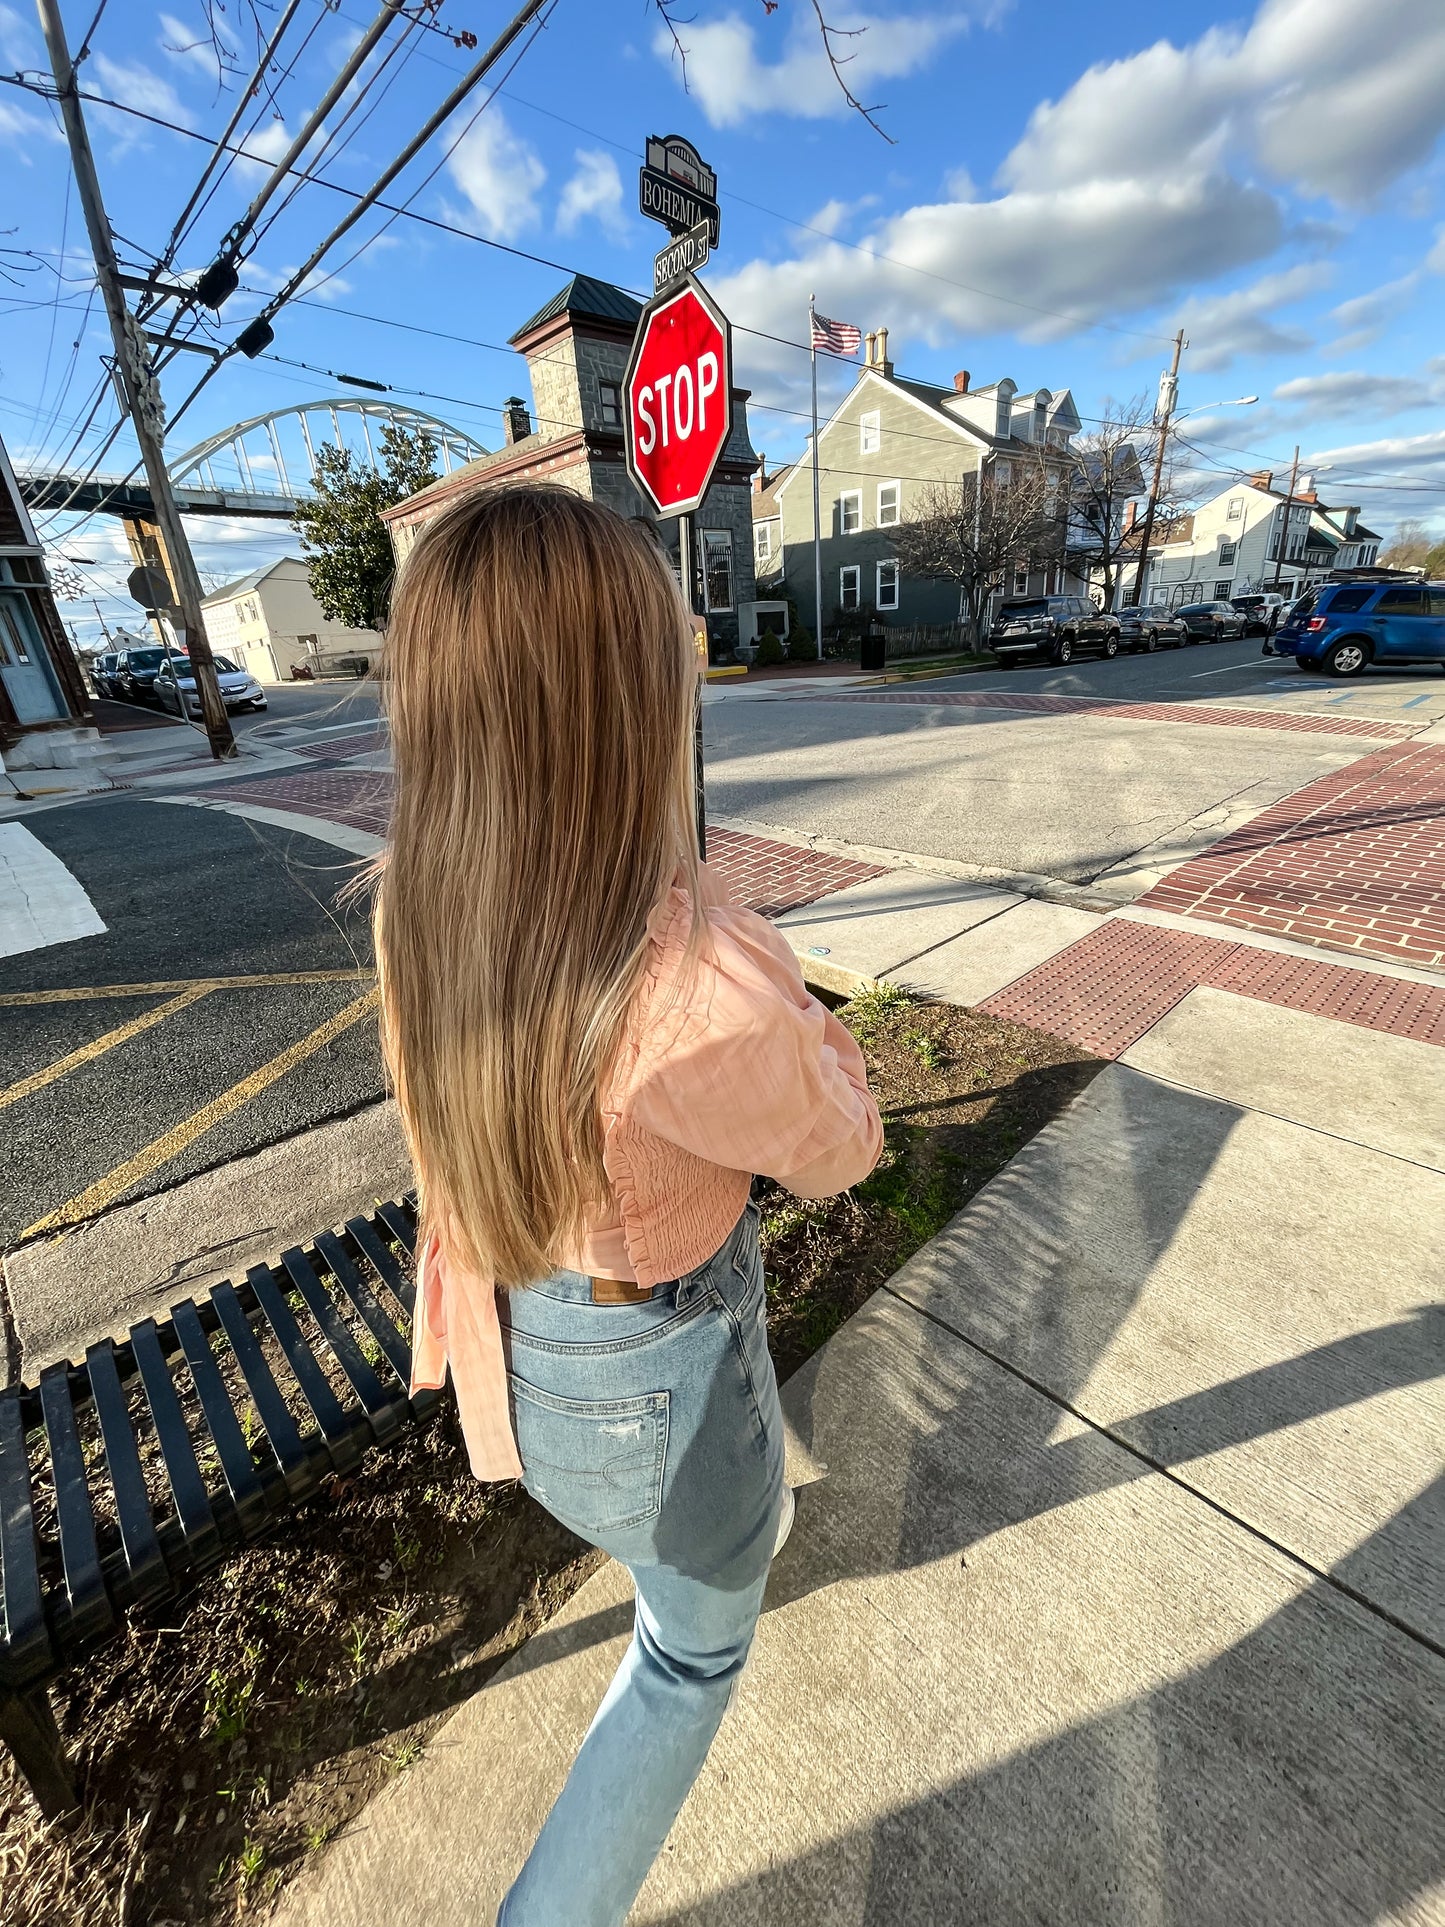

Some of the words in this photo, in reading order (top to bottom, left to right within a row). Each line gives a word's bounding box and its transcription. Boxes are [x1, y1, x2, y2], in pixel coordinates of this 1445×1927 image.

[643, 178, 702, 228] BOHEMIA
[656, 238, 695, 286] SECOND
[697, 235, 707, 259] ST
[638, 351, 719, 455] STOP
